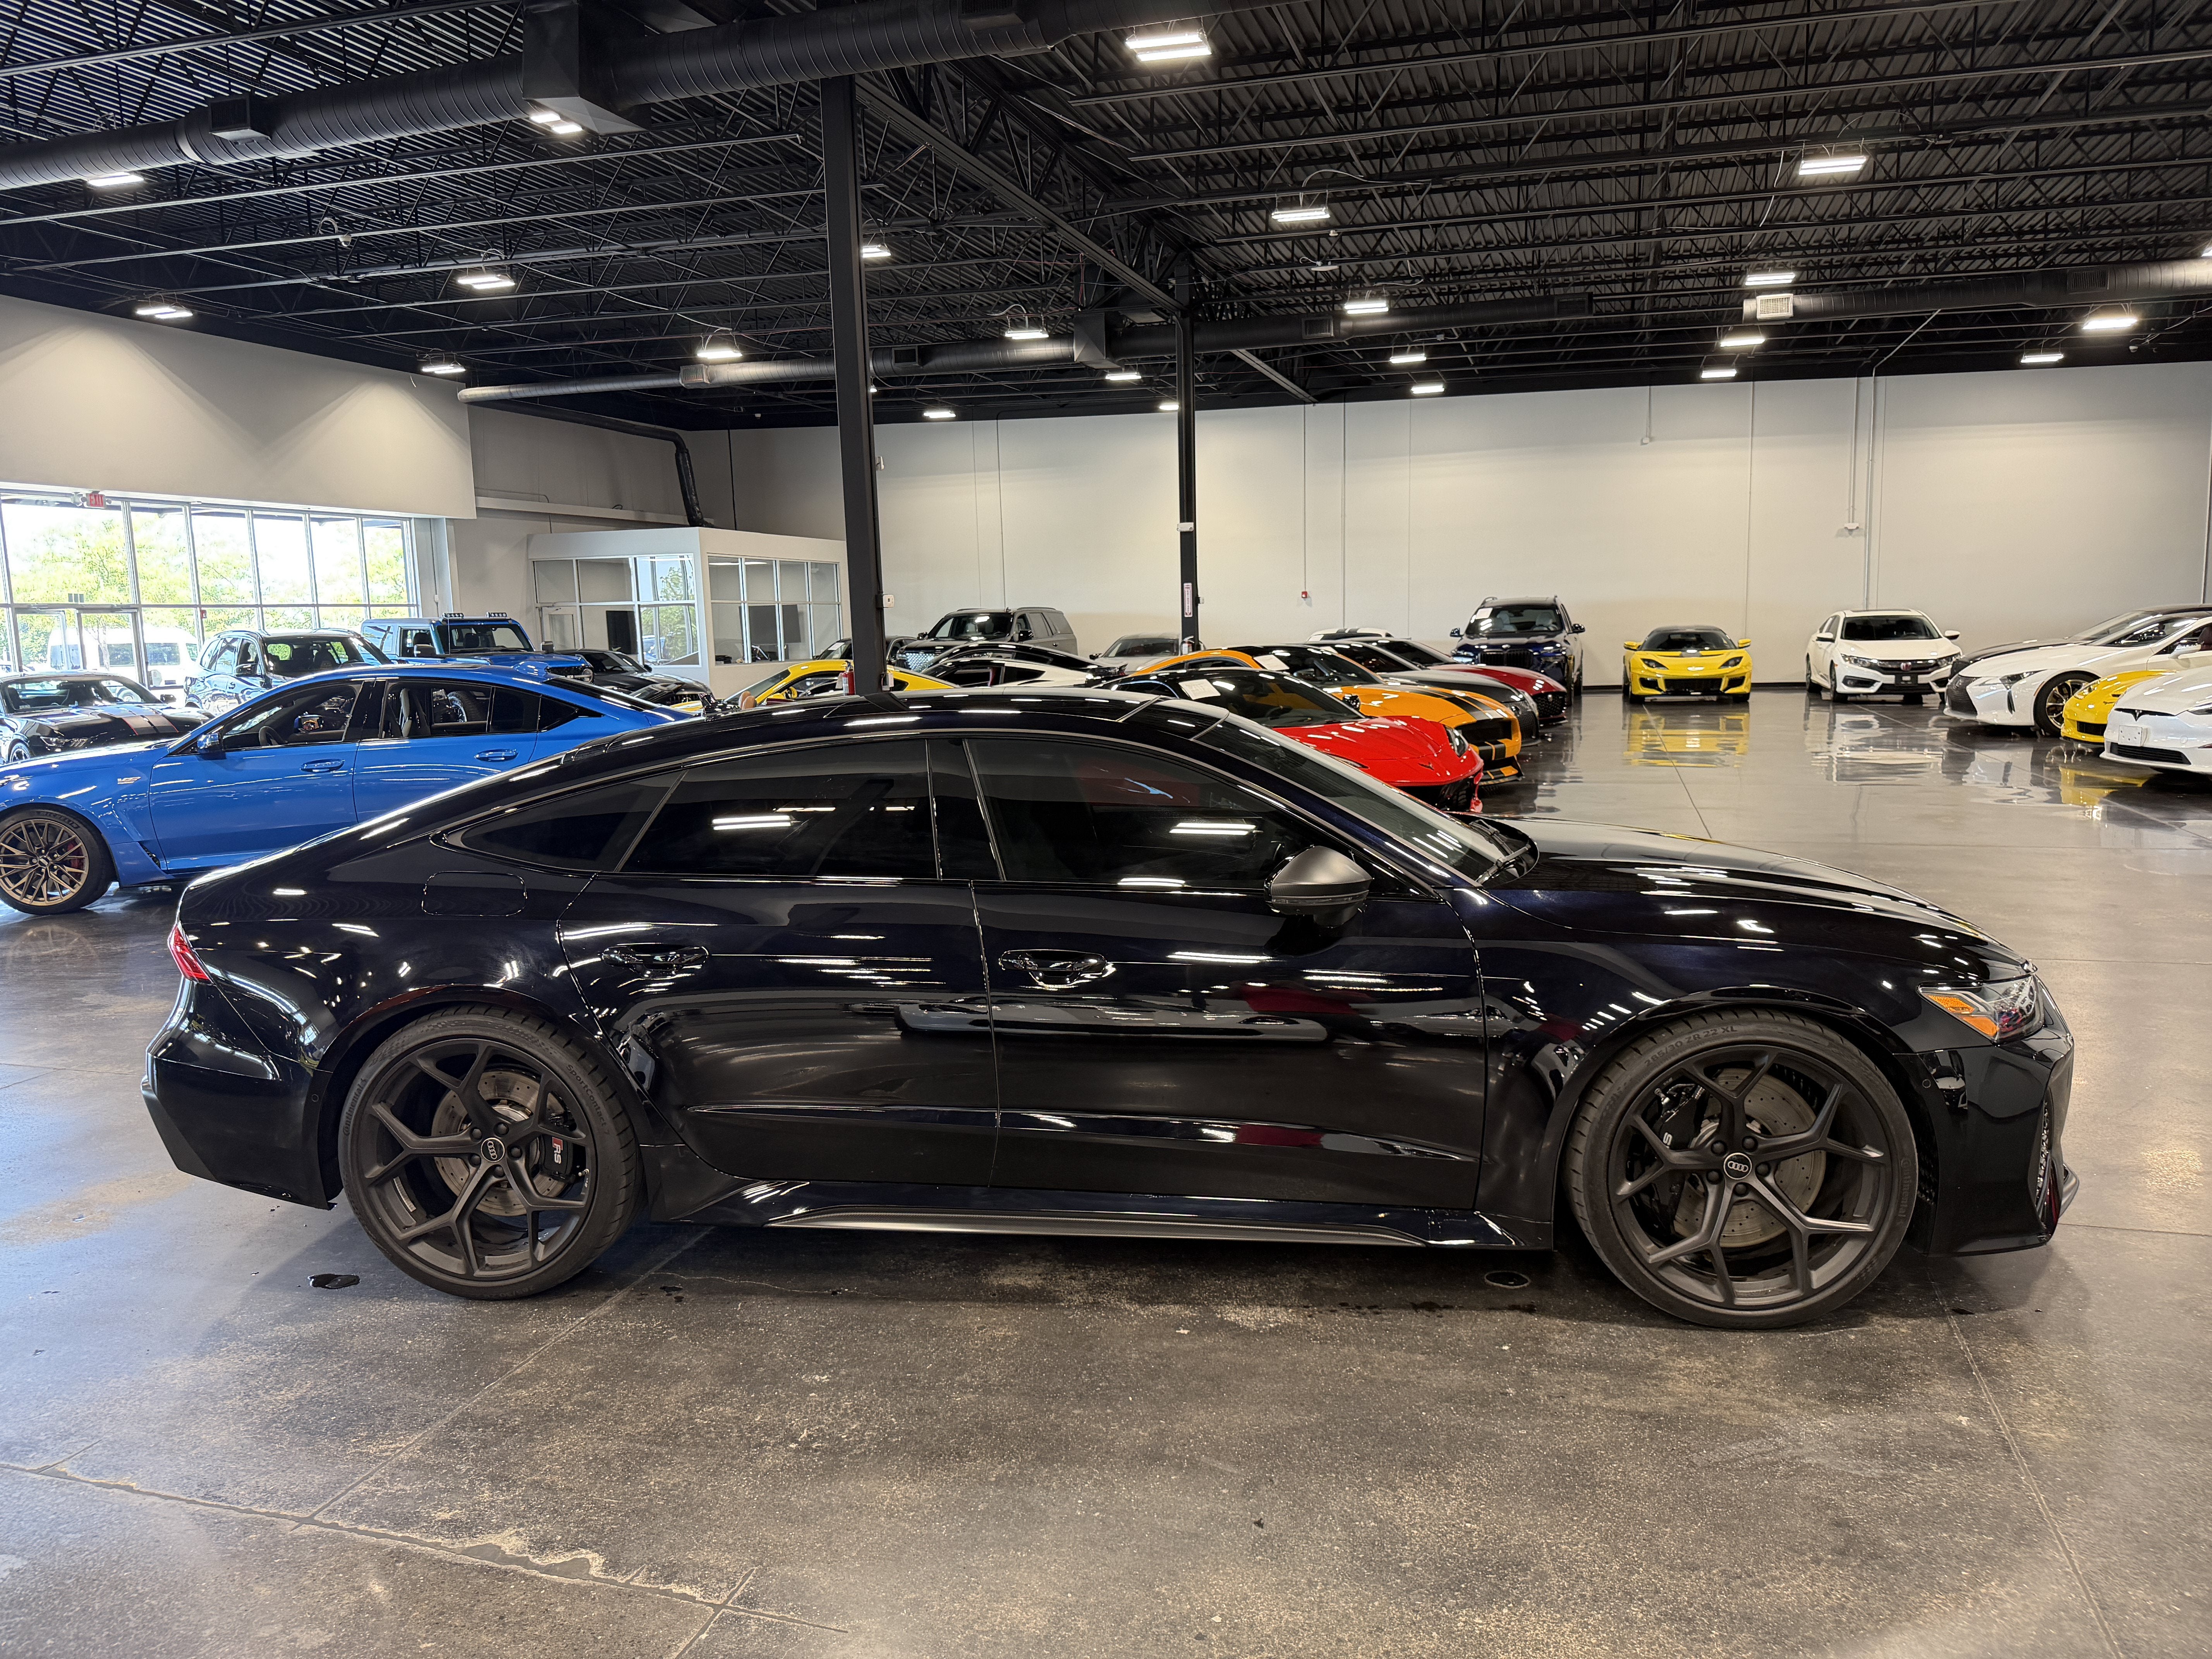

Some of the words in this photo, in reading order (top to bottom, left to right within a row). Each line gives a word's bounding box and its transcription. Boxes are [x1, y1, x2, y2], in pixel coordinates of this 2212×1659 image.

[89, 493, 104, 507] EXIT
[1644, 1040, 1683, 1065] 285/30
[1685, 1034, 1702, 1043] ZR
[1703, 1028, 1719, 1037] 22
[342, 1083, 364, 1136] Continental
[554, 1143, 562, 1164] RS
